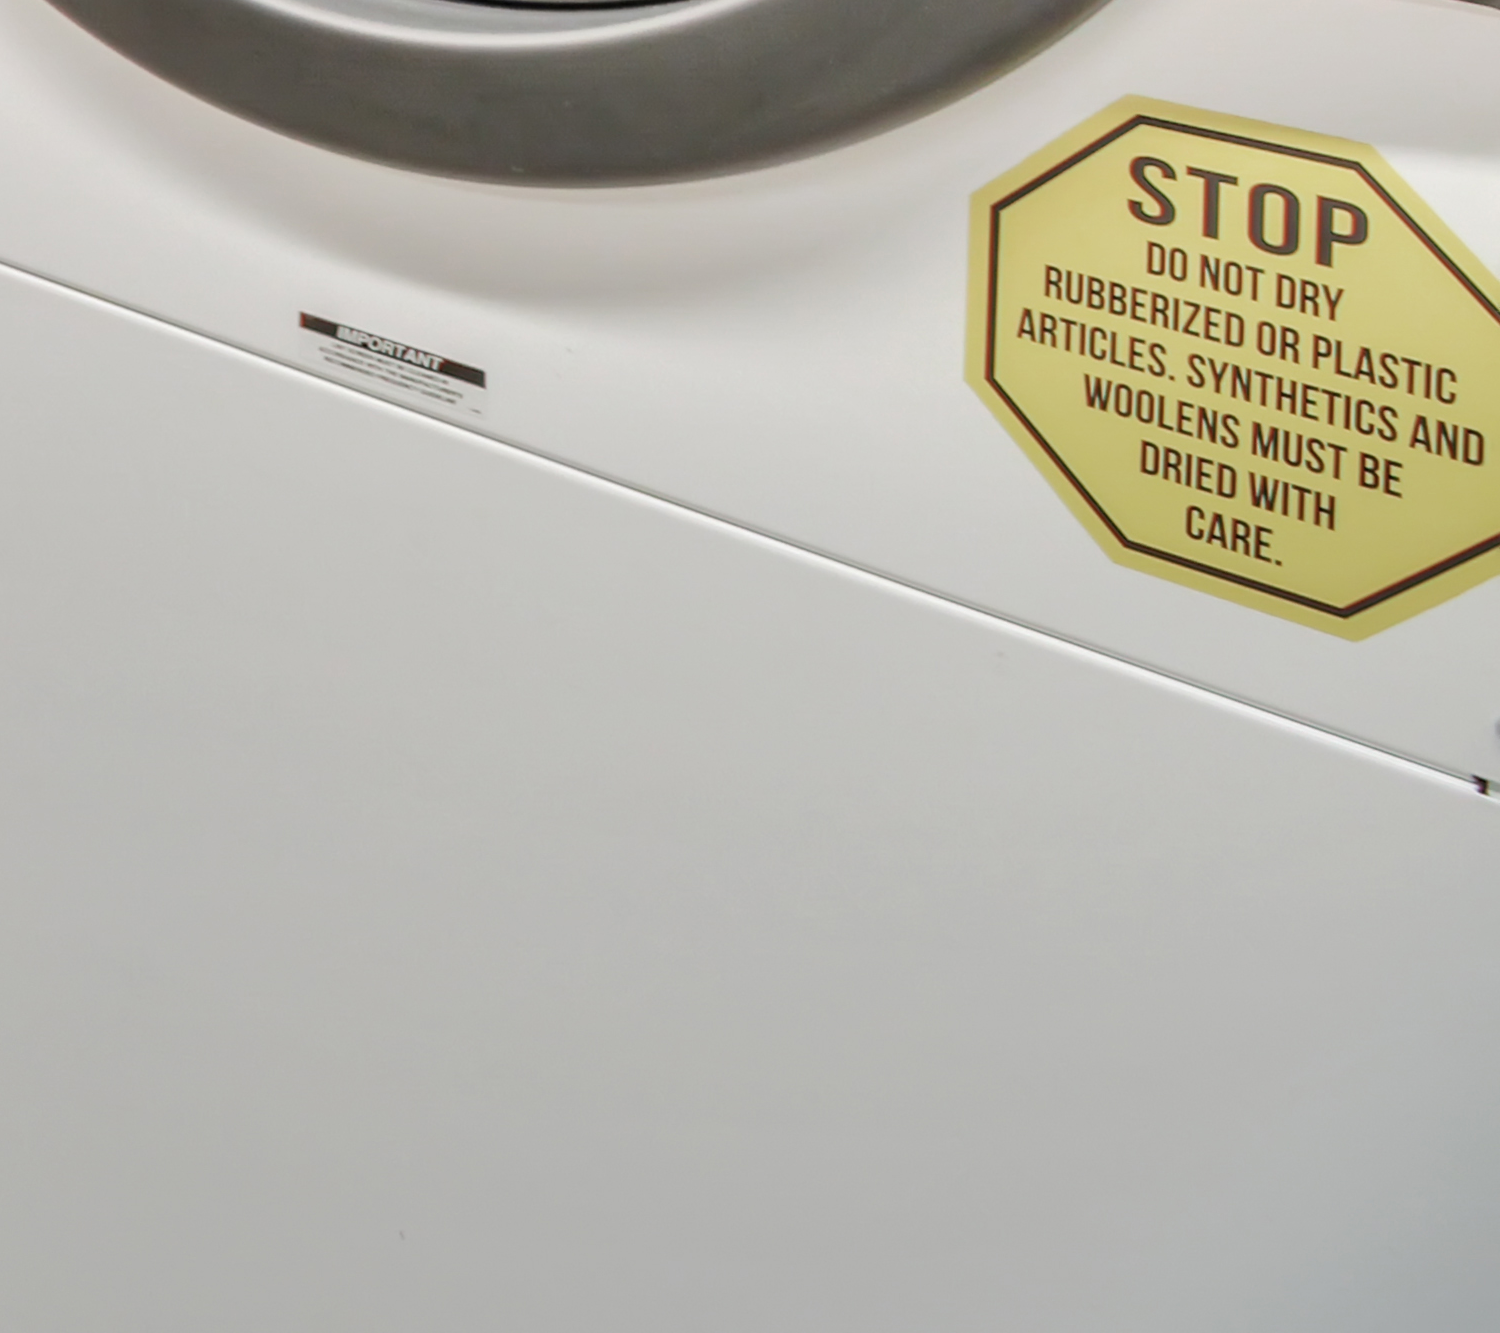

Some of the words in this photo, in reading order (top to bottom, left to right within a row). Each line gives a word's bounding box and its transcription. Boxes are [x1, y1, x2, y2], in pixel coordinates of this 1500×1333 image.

[1127, 155, 1368, 268] STOP
[1146, 240, 1188, 282] DO
[1200, 254, 1265, 303] NOT
[1276, 273, 1345, 321] DRY
[336, 325, 445, 371] IMPORTANT
[1044, 265, 1245, 348] RUBBERIZED
[1256, 320, 1300, 363] OR
[1311, 334, 1458, 405] PLASTIC
[1017, 308, 1176, 382] ARTICLES.
[1187, 354, 1398, 441] SYNTHETICS
[1409, 415, 1484, 466] AND
[1084, 374, 1239, 449] WOOLENS
[1252, 421, 1348, 480] MUST
[1359, 455, 1403, 499] BE
[1140, 439, 1237, 499] DRIED
[1249, 473, 1336, 531] WITH
[1185, 505, 1282, 566] CARE.
